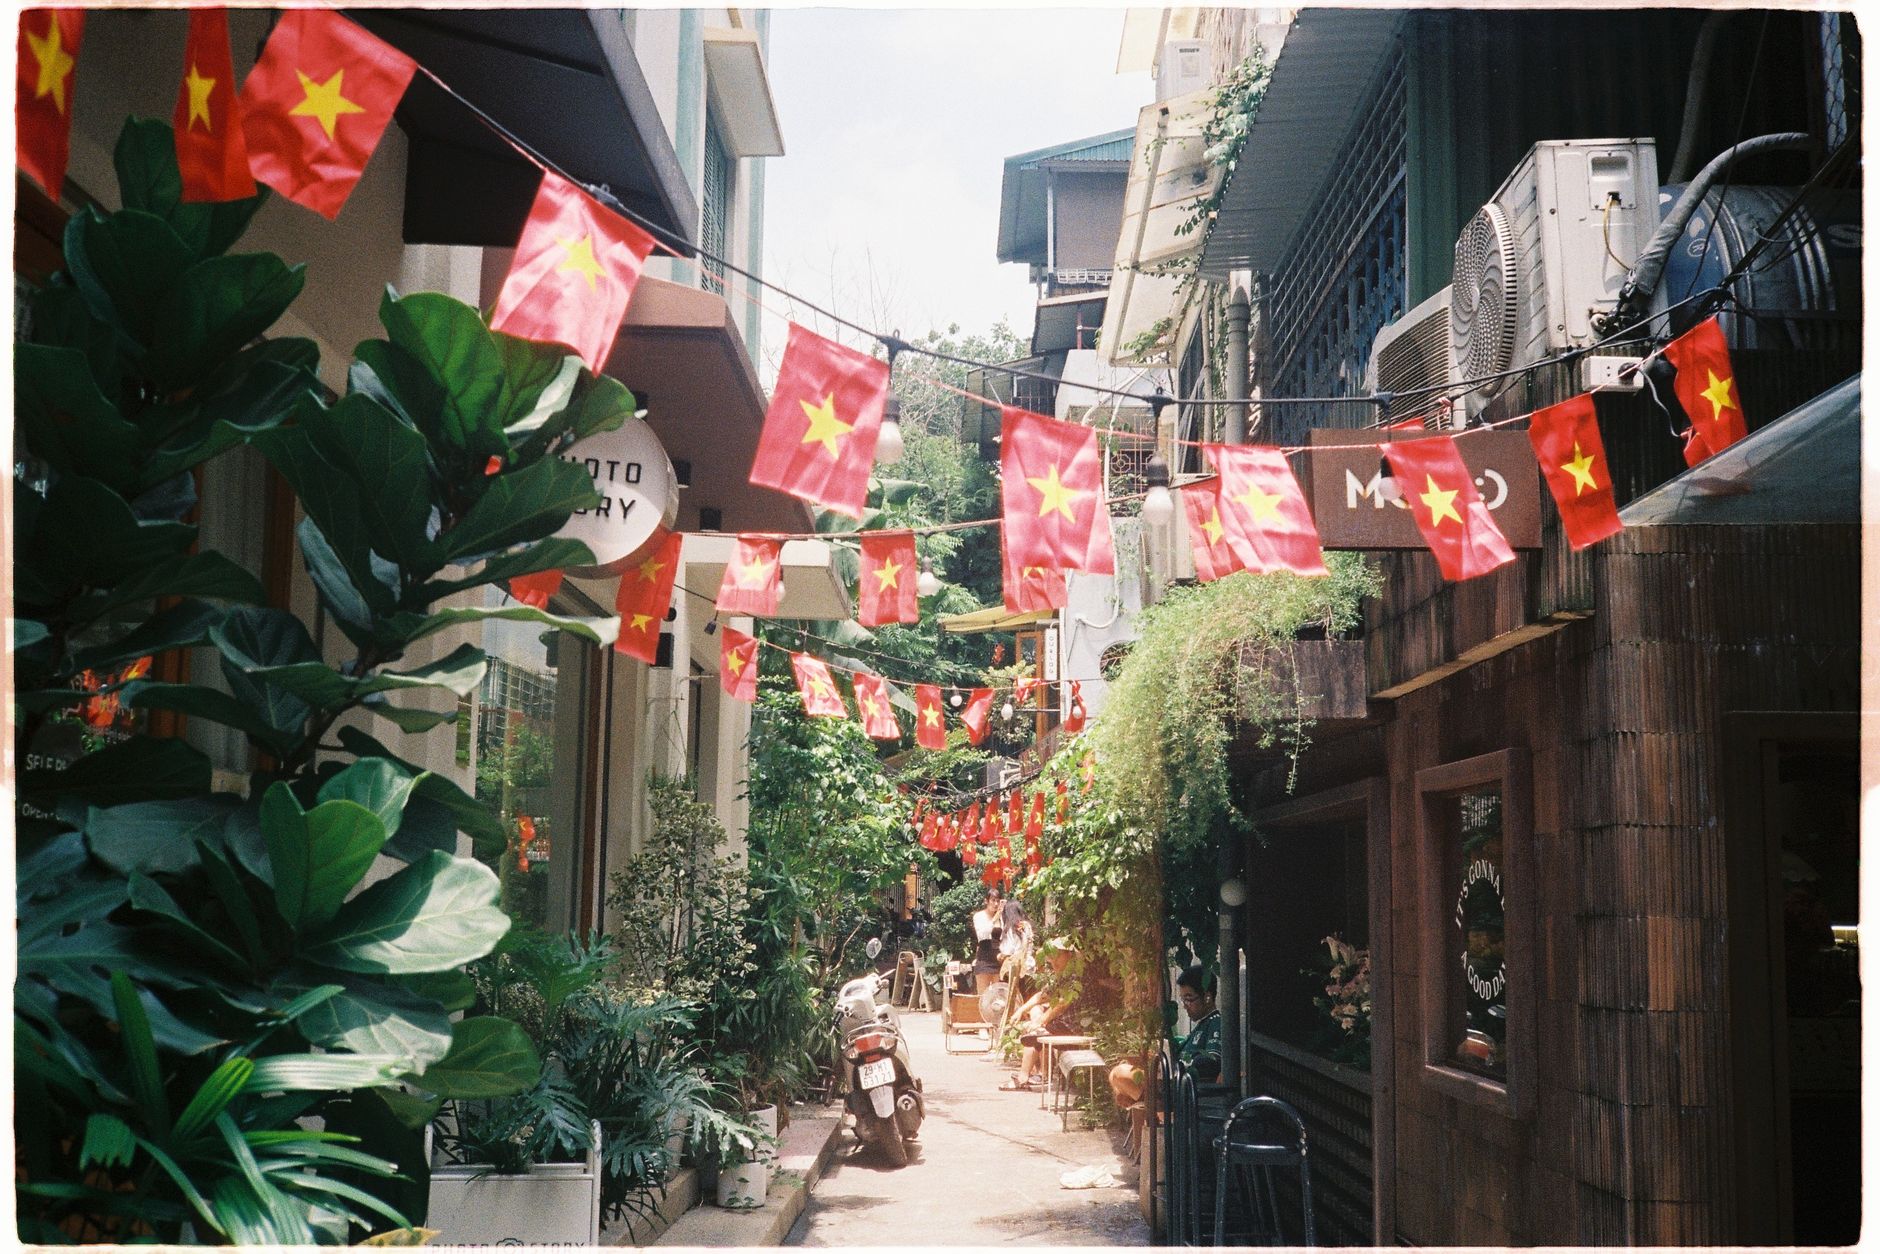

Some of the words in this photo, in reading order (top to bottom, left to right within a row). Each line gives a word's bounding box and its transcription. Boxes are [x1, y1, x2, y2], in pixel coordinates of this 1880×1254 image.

[561, 456, 642, 484] OTO
[1455, 879, 1469, 930] IT'S
[1468, 859, 1500, 895] GONNA
[1467, 965, 1492, 1000] GOOD
